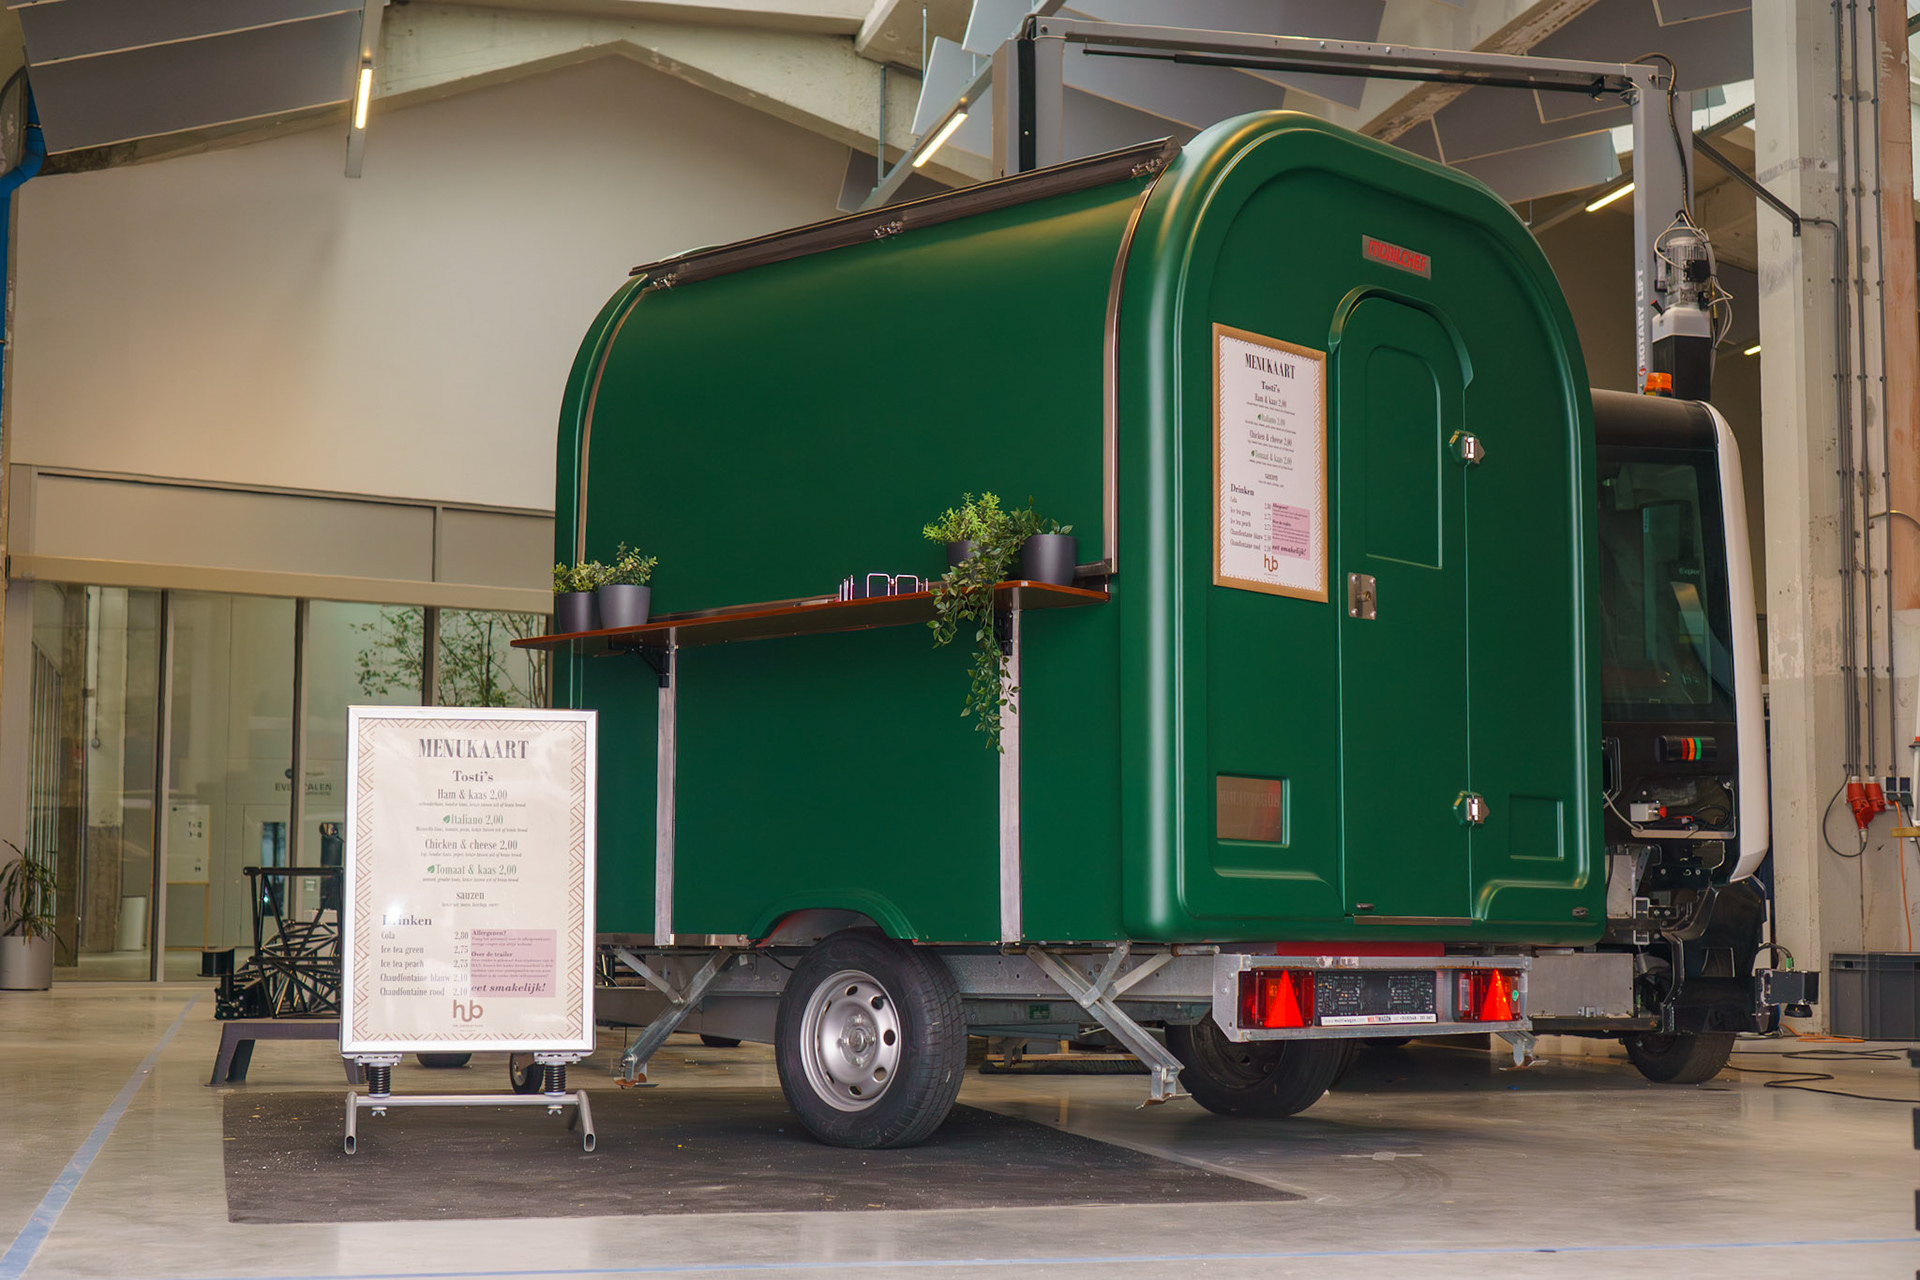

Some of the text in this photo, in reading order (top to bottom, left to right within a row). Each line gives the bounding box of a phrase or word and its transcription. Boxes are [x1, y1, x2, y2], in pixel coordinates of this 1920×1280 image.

[1245, 353, 1295, 379] MENUKAART
[1230, 483, 1254, 496] Drinken
[418, 738, 529, 759] MENUKAART
[452, 770, 494, 782] Tosti's
[437, 789, 456, 799] Ham
[459, 789, 465, 799] &
[468, 789, 487, 799] kaas
[451, 814, 483, 824] Italiano
[425, 839, 457, 849] Chicken
[460, 839, 466, 849] &
[469, 839, 497, 849] cheese
[436, 864, 465, 874] Tomaat
[467, 864, 474, 874] &
[478, 864, 496, 874] kaas
[455, 891, 485, 900] sauzen
[381, 931, 395, 939] Cola
[380, 945, 424, 955] Ice tea green
[380, 959, 424, 970] Ice tea peach
[380, 973, 450, 982] Chaudfontaine blauw
[379, 987, 445, 996] Chaudfontaine rood
[471, 983, 546, 994] eet smakelijk!
